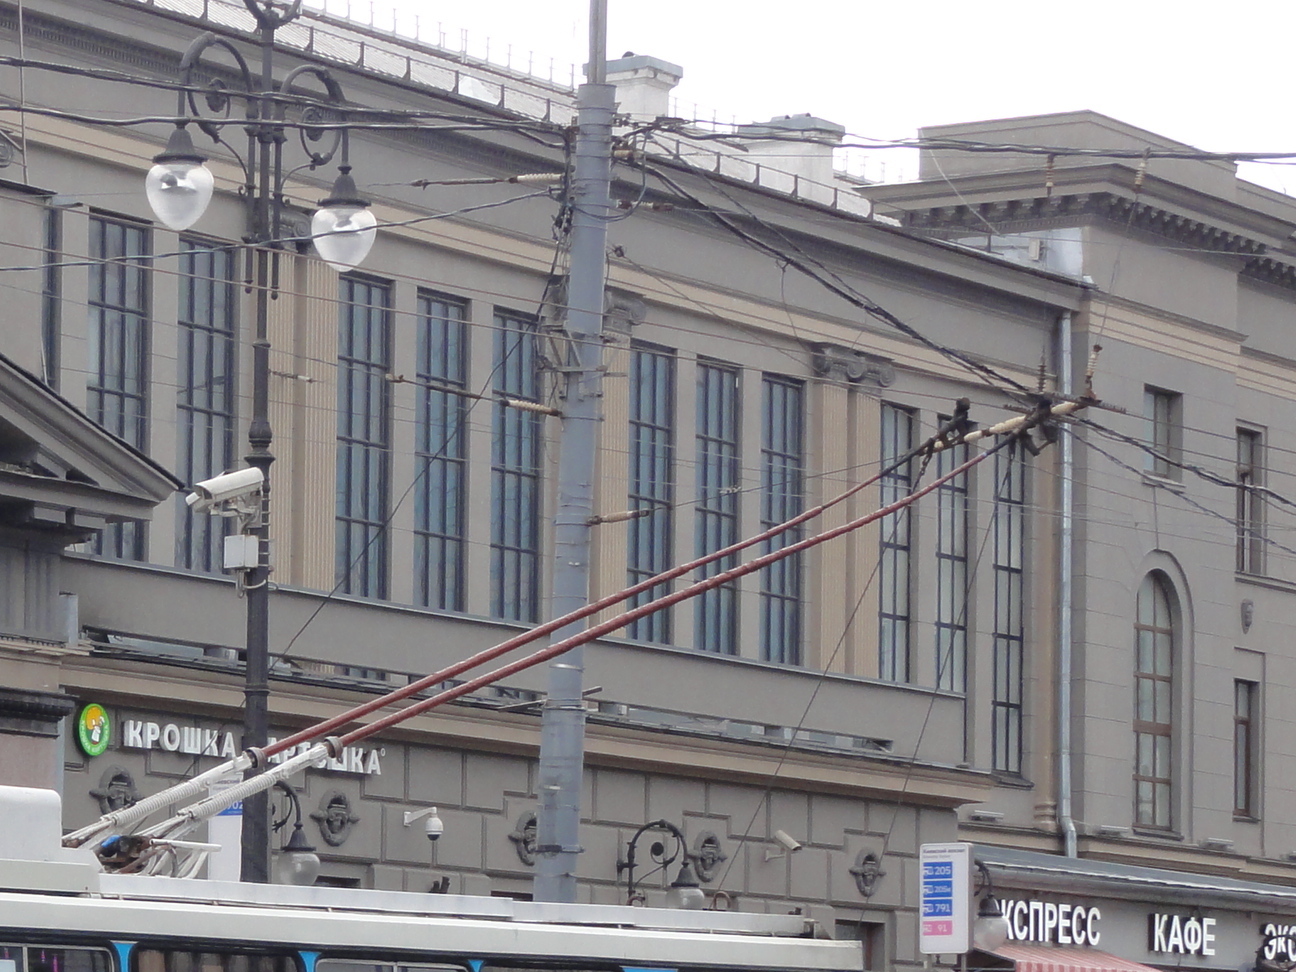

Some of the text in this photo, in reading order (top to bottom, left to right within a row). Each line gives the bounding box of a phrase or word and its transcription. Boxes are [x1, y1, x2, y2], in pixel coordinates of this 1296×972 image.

[124, 720, 236, 758] КРОШКА
[934, 866, 951, 875] 205
[935, 904, 951, 913] 791
[937, 924, 947, 932] 91
[1001, 899, 1101, 946] КСПРЕСС
[1153, 913, 1216, 956] КАФЕ
